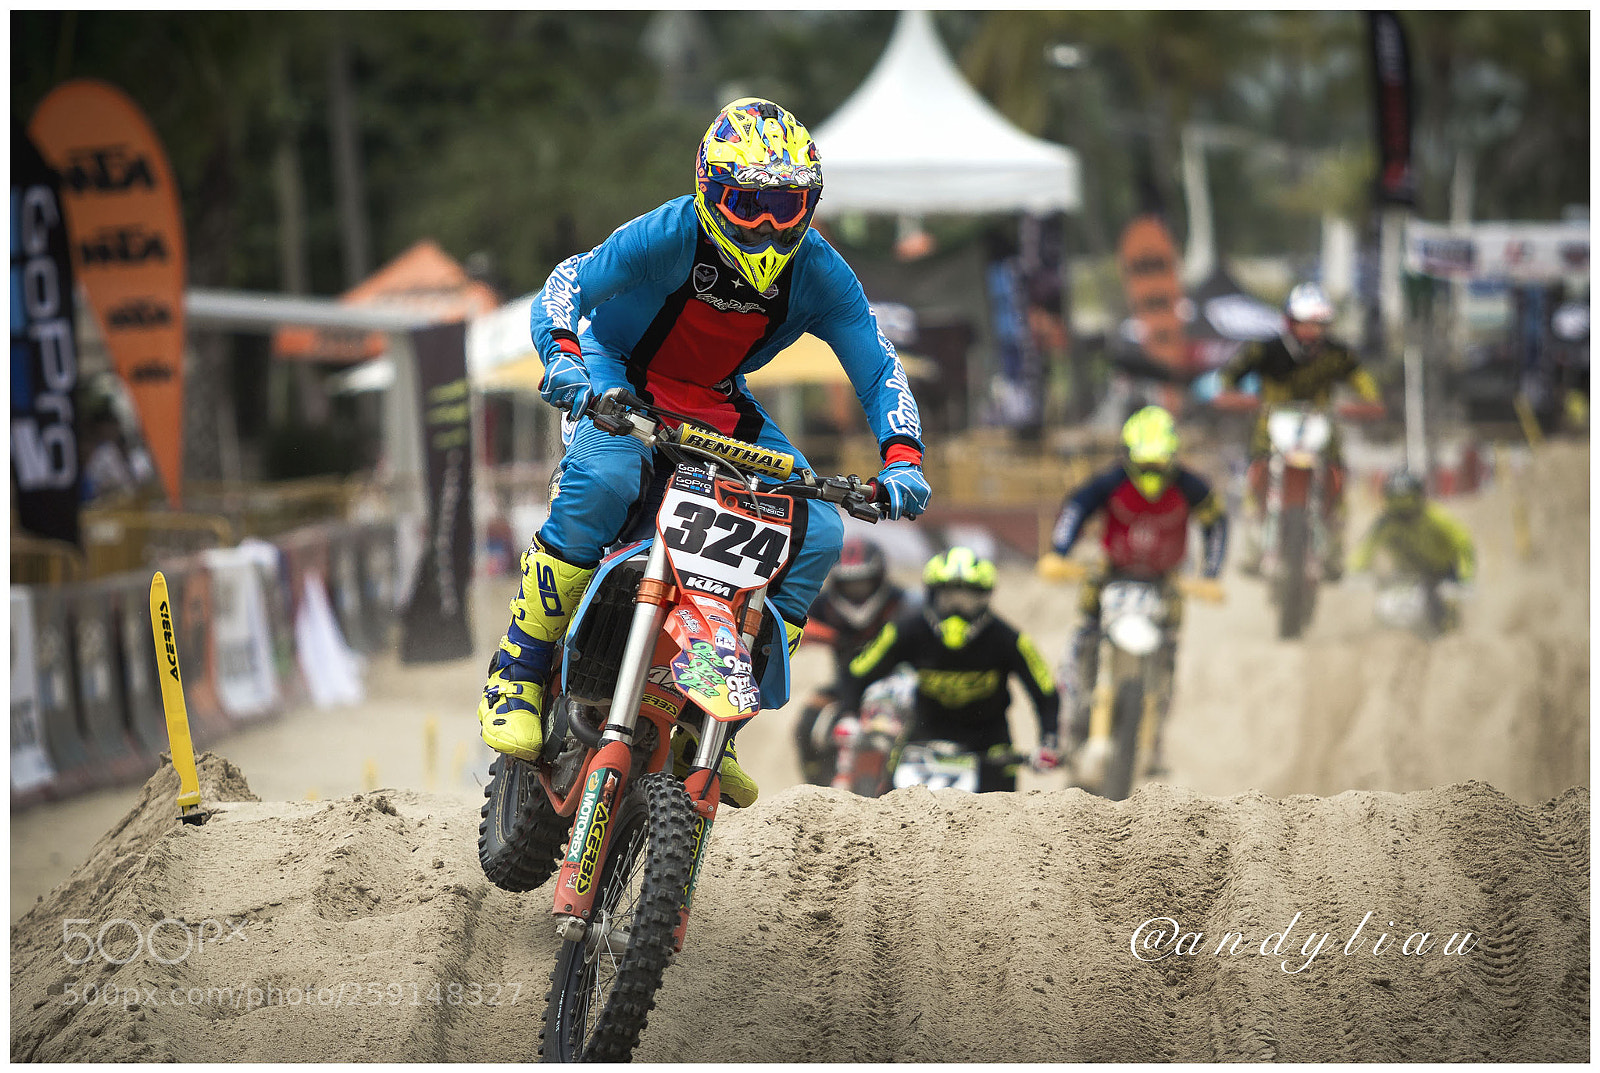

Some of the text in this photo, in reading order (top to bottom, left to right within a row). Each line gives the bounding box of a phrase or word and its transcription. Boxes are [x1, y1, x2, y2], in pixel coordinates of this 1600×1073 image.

[676, 476, 712, 489] GoPro
[685, 434, 786, 471] RENTHAL
[663, 501, 788, 580] 324
[686, 576, 731, 597] KTM
[160, 601, 179, 682] ACERBIS
[569, 792, 596, 859] MOTOREX
[576, 803, 609, 895] ACERBIS
